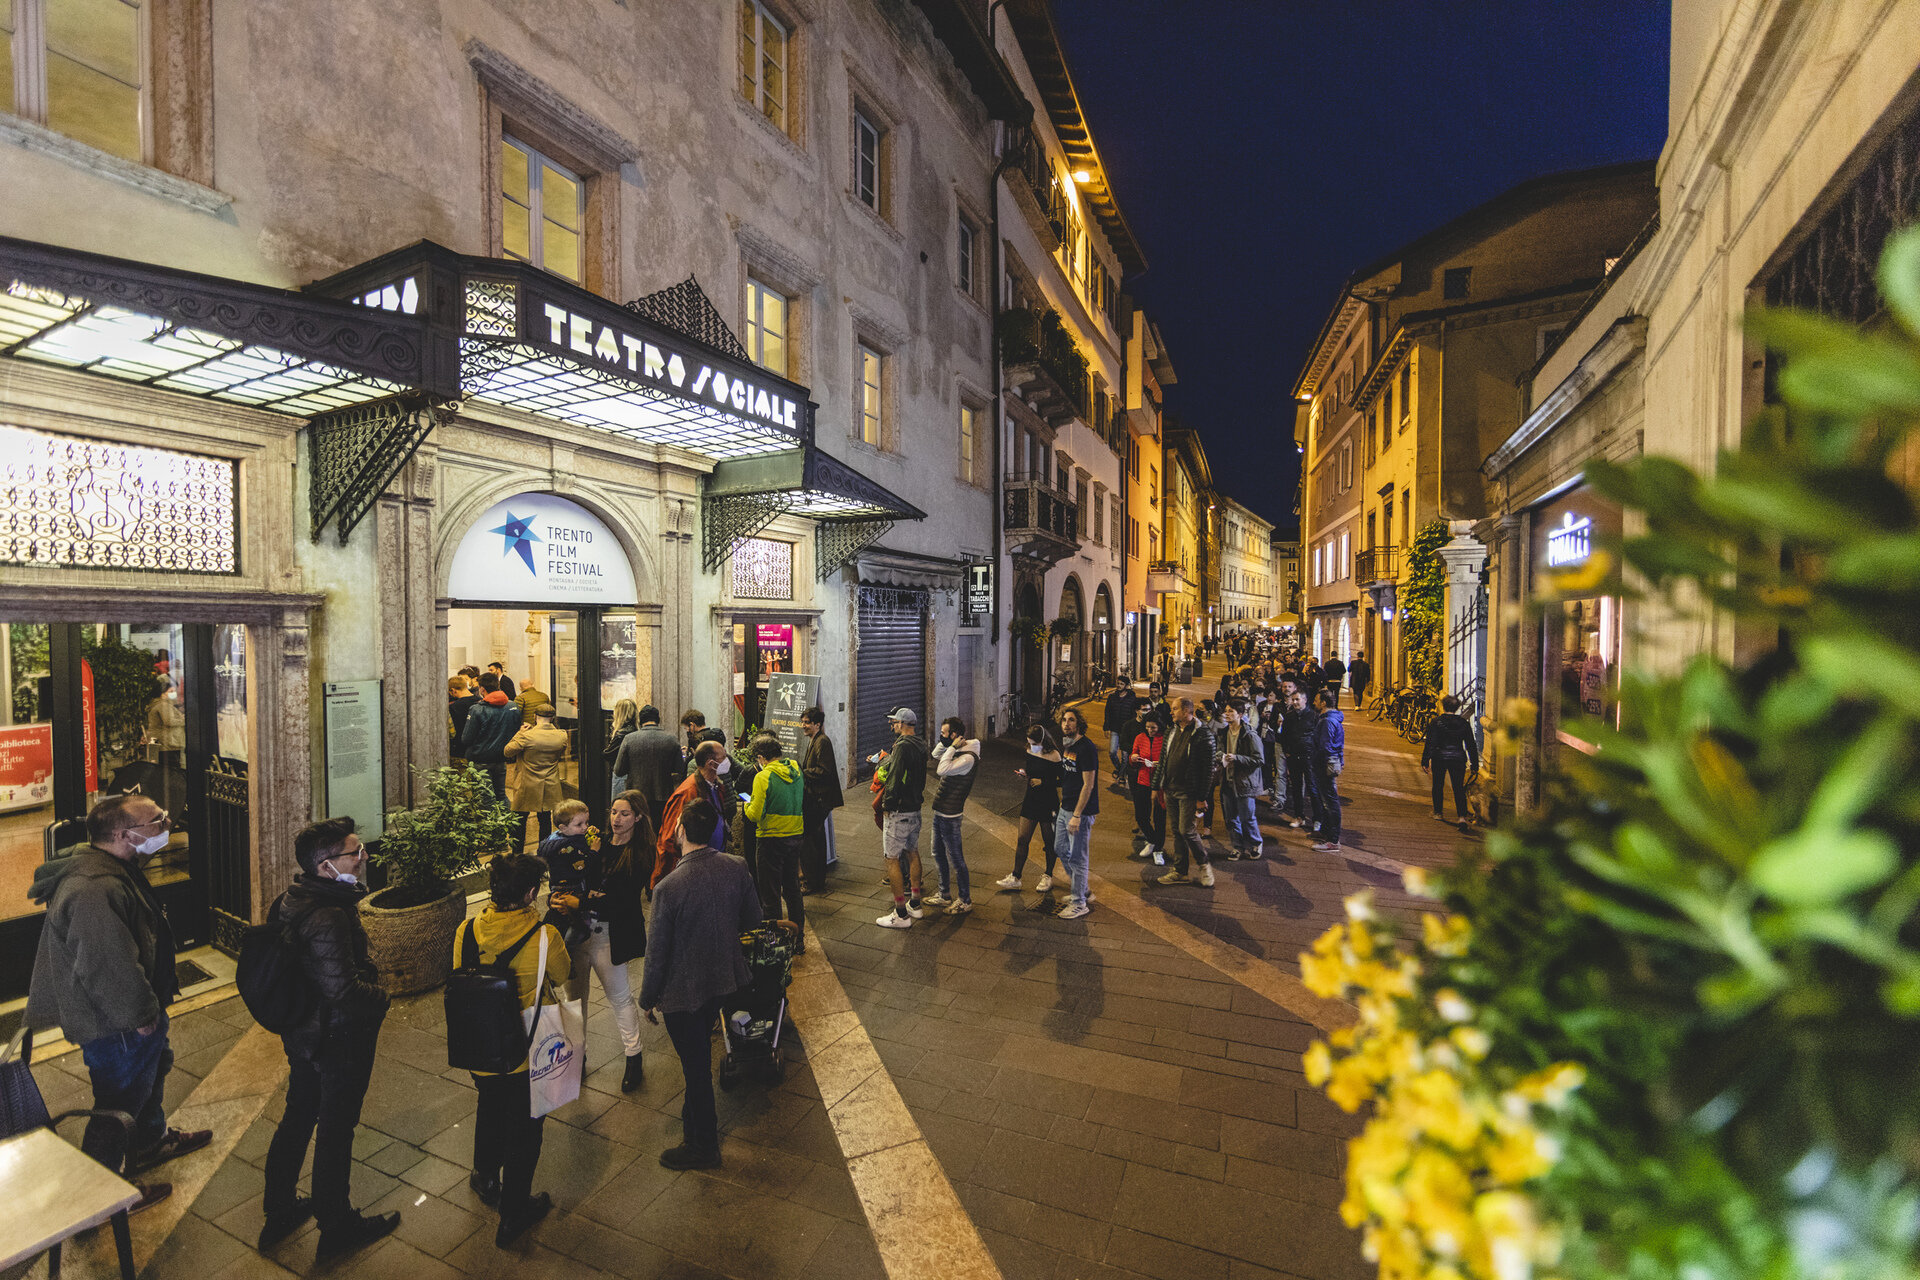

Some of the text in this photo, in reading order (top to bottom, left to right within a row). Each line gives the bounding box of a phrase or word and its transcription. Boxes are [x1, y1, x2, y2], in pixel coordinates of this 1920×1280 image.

[544, 303, 797, 430] TEATRO SOCIALE
[547, 526, 592, 543] TRENTO
[548, 544, 576, 558] FILM
[548, 560, 603, 576] FESTIVAL
[972, 566, 987, 591] T
